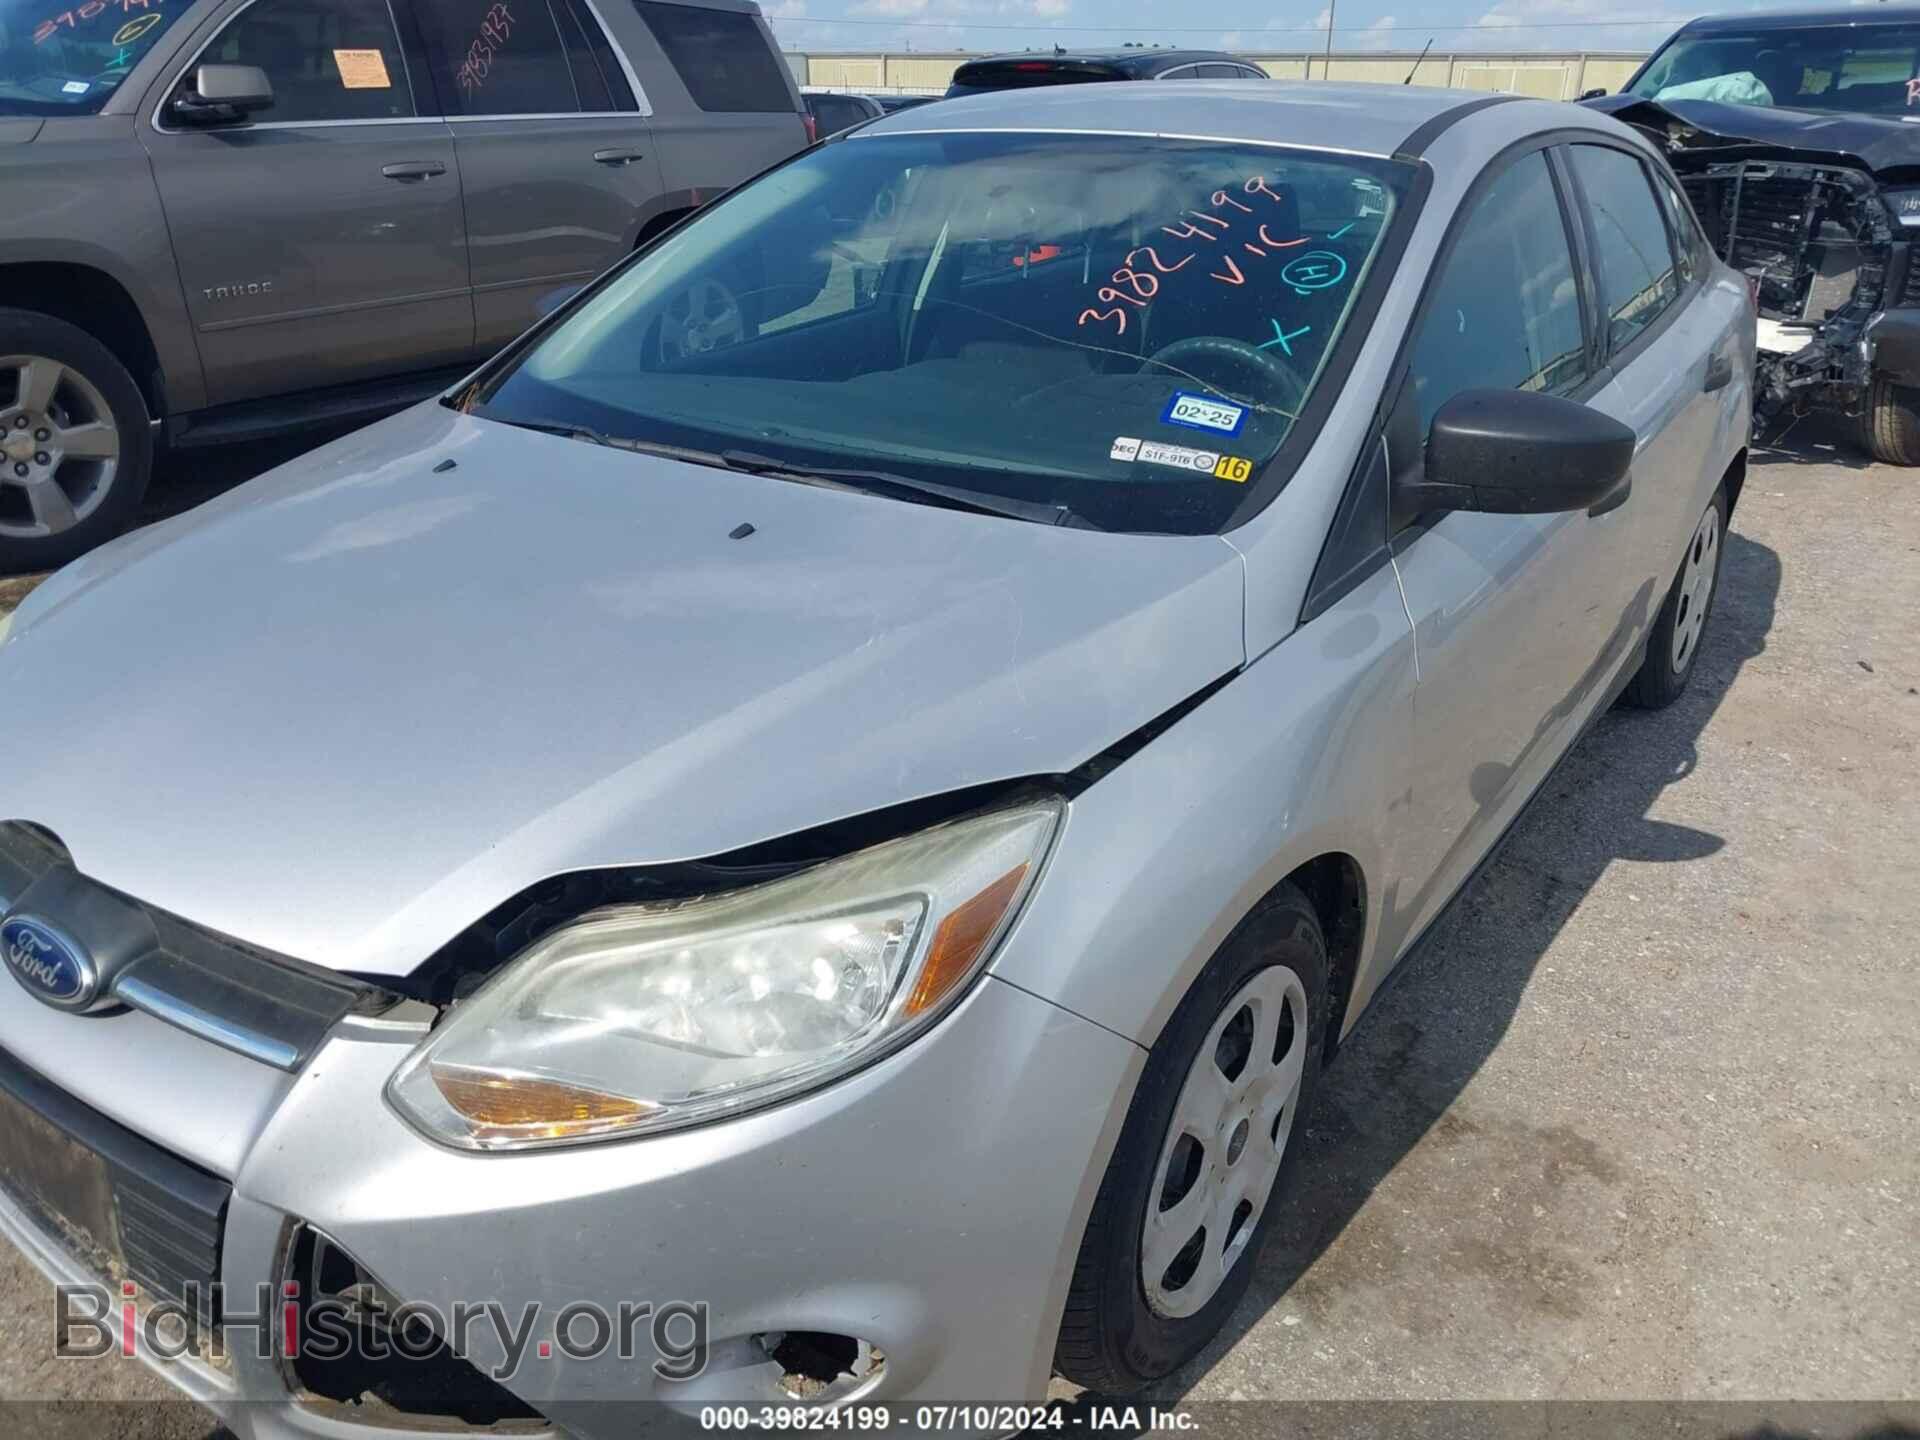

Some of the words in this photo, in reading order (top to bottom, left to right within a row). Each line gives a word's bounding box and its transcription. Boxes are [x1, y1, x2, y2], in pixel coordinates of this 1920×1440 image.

[1077, 175, 1282, 336] 39824199
[202, 281, 273, 300] TAHOE
[1221, 457, 1247, 479] 16
[9, 928, 63, 987] Ford
